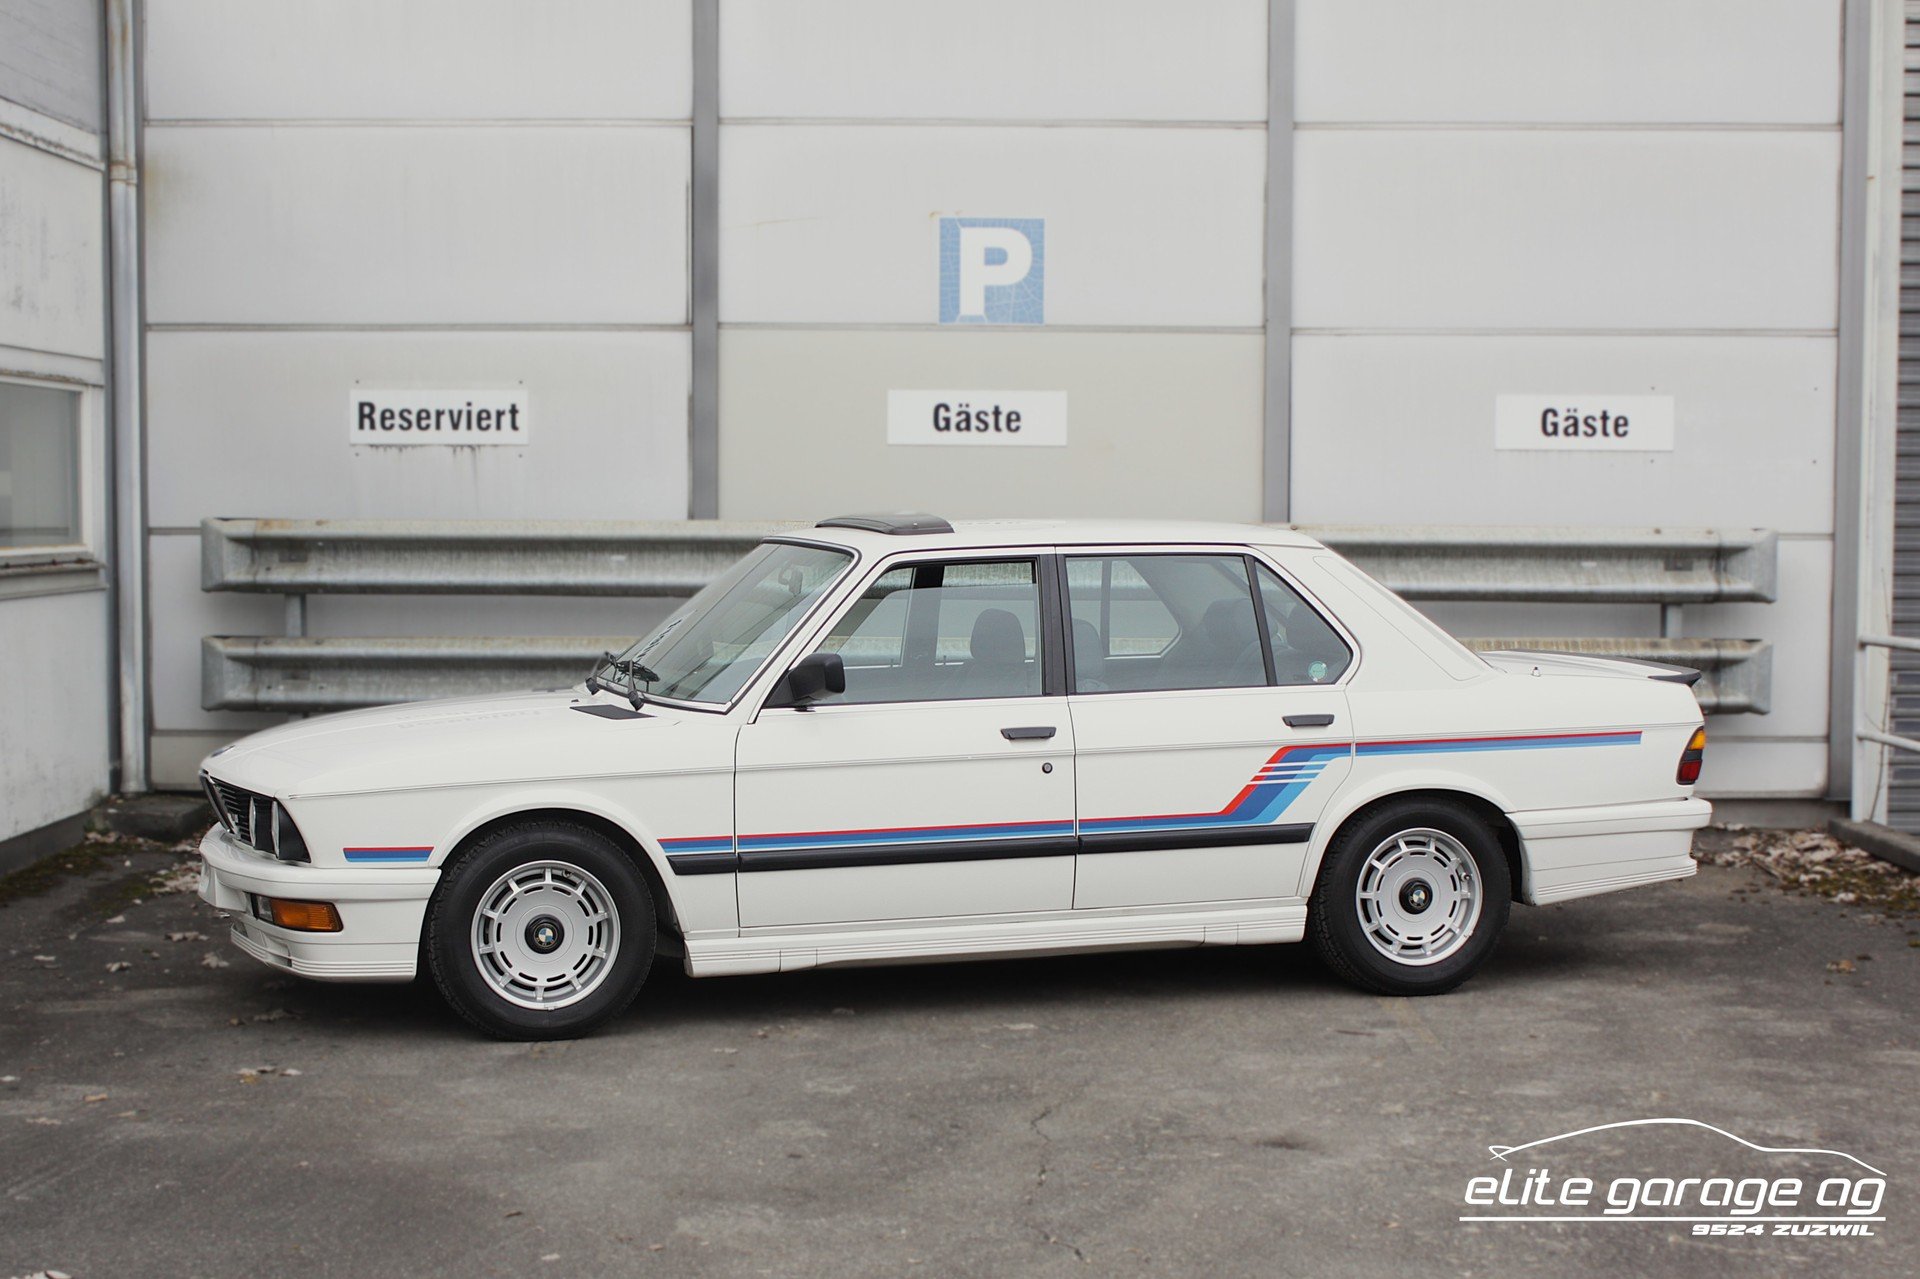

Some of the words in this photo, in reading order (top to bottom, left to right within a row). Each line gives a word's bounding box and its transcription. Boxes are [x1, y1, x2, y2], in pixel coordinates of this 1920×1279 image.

[959, 227, 1033, 316] P
[358, 401, 519, 432] Reserviert
[933, 402, 1021, 433] Gäste
[1541, 407, 1629, 438] Gäste
